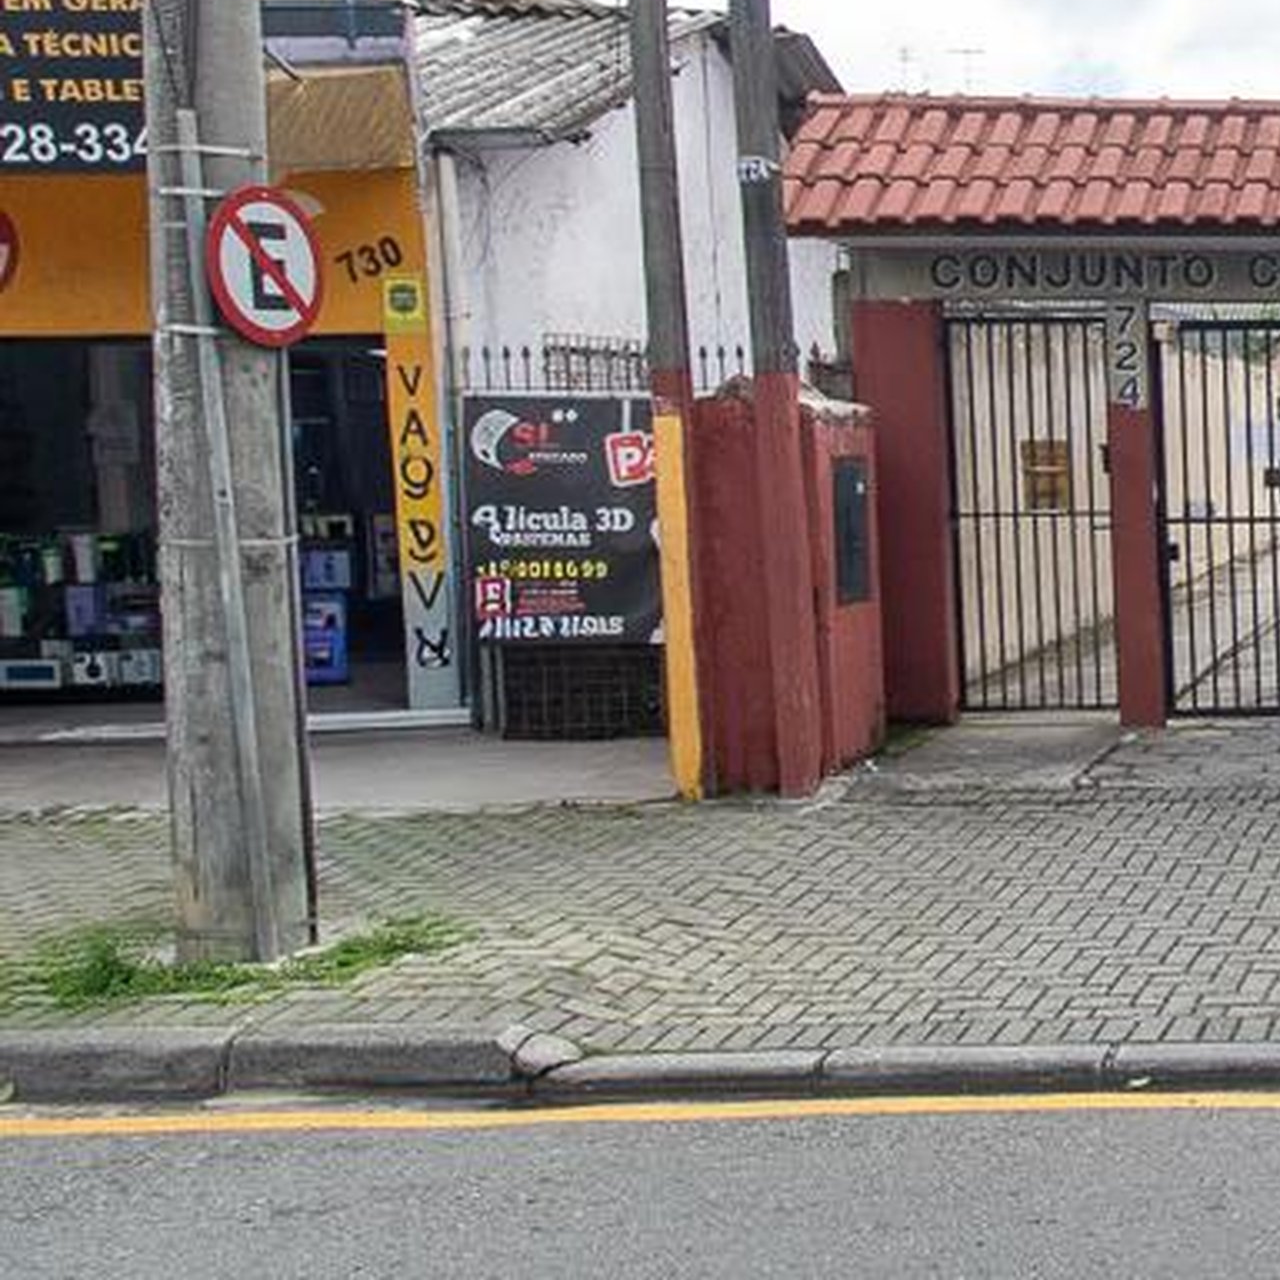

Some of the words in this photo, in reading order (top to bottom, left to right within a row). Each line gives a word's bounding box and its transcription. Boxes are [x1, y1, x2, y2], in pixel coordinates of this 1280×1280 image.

[22, 29, 142, 57] TÉCNIC
[39, 78, 144, 102] TABLE
[0, 123, 148, 162] 28-334
[249, 222, 294, 310] E
[334, 235, 403, 283] 730
[931, 253, 1215, 289] CONJUNTO
[595, 507, 636, 533] 3D
